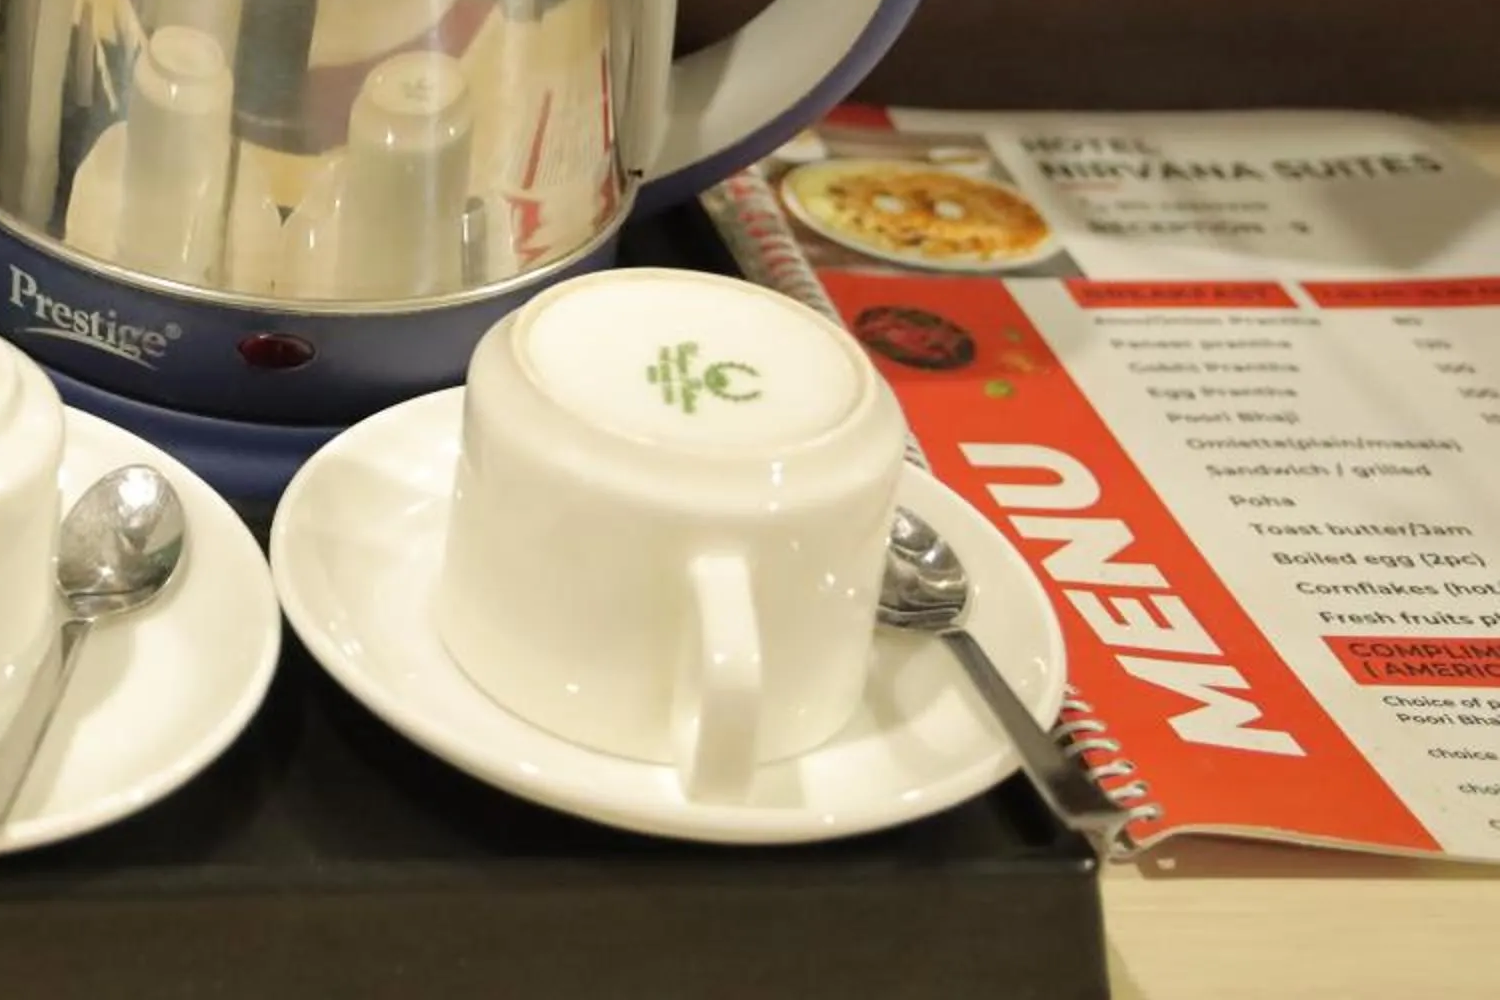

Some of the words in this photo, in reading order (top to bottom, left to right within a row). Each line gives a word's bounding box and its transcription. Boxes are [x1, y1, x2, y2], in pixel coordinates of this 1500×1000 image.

[1020, 134, 1161, 156] HOTEL
[1037, 157, 1263, 182] NIRVANA
[1271, 152, 1444, 181] SUITES
[1205, 463, 1331, 478] Sandwich
[1350, 463, 1433, 480] grilled
[1228, 494, 1298, 508] Poha
[1250, 521, 1324, 536] Toast
[1271, 552, 1358, 566] Boiled
[1364, 553, 1415, 569] egg
[1420, 552, 1488, 569] (2pc)
[1295, 580, 1440, 596] Cornflakes
[957, 442, 1308, 757] MENU
[1318, 610, 1397, 625] Fresh
[1400, 610, 1475, 626] fruits
[1381, 694, 1456, 708] Choice
[1460, 696, 1483, 709] of
[1395, 712, 1454, 726] Poori
[1427, 747, 1499, 762] choice
